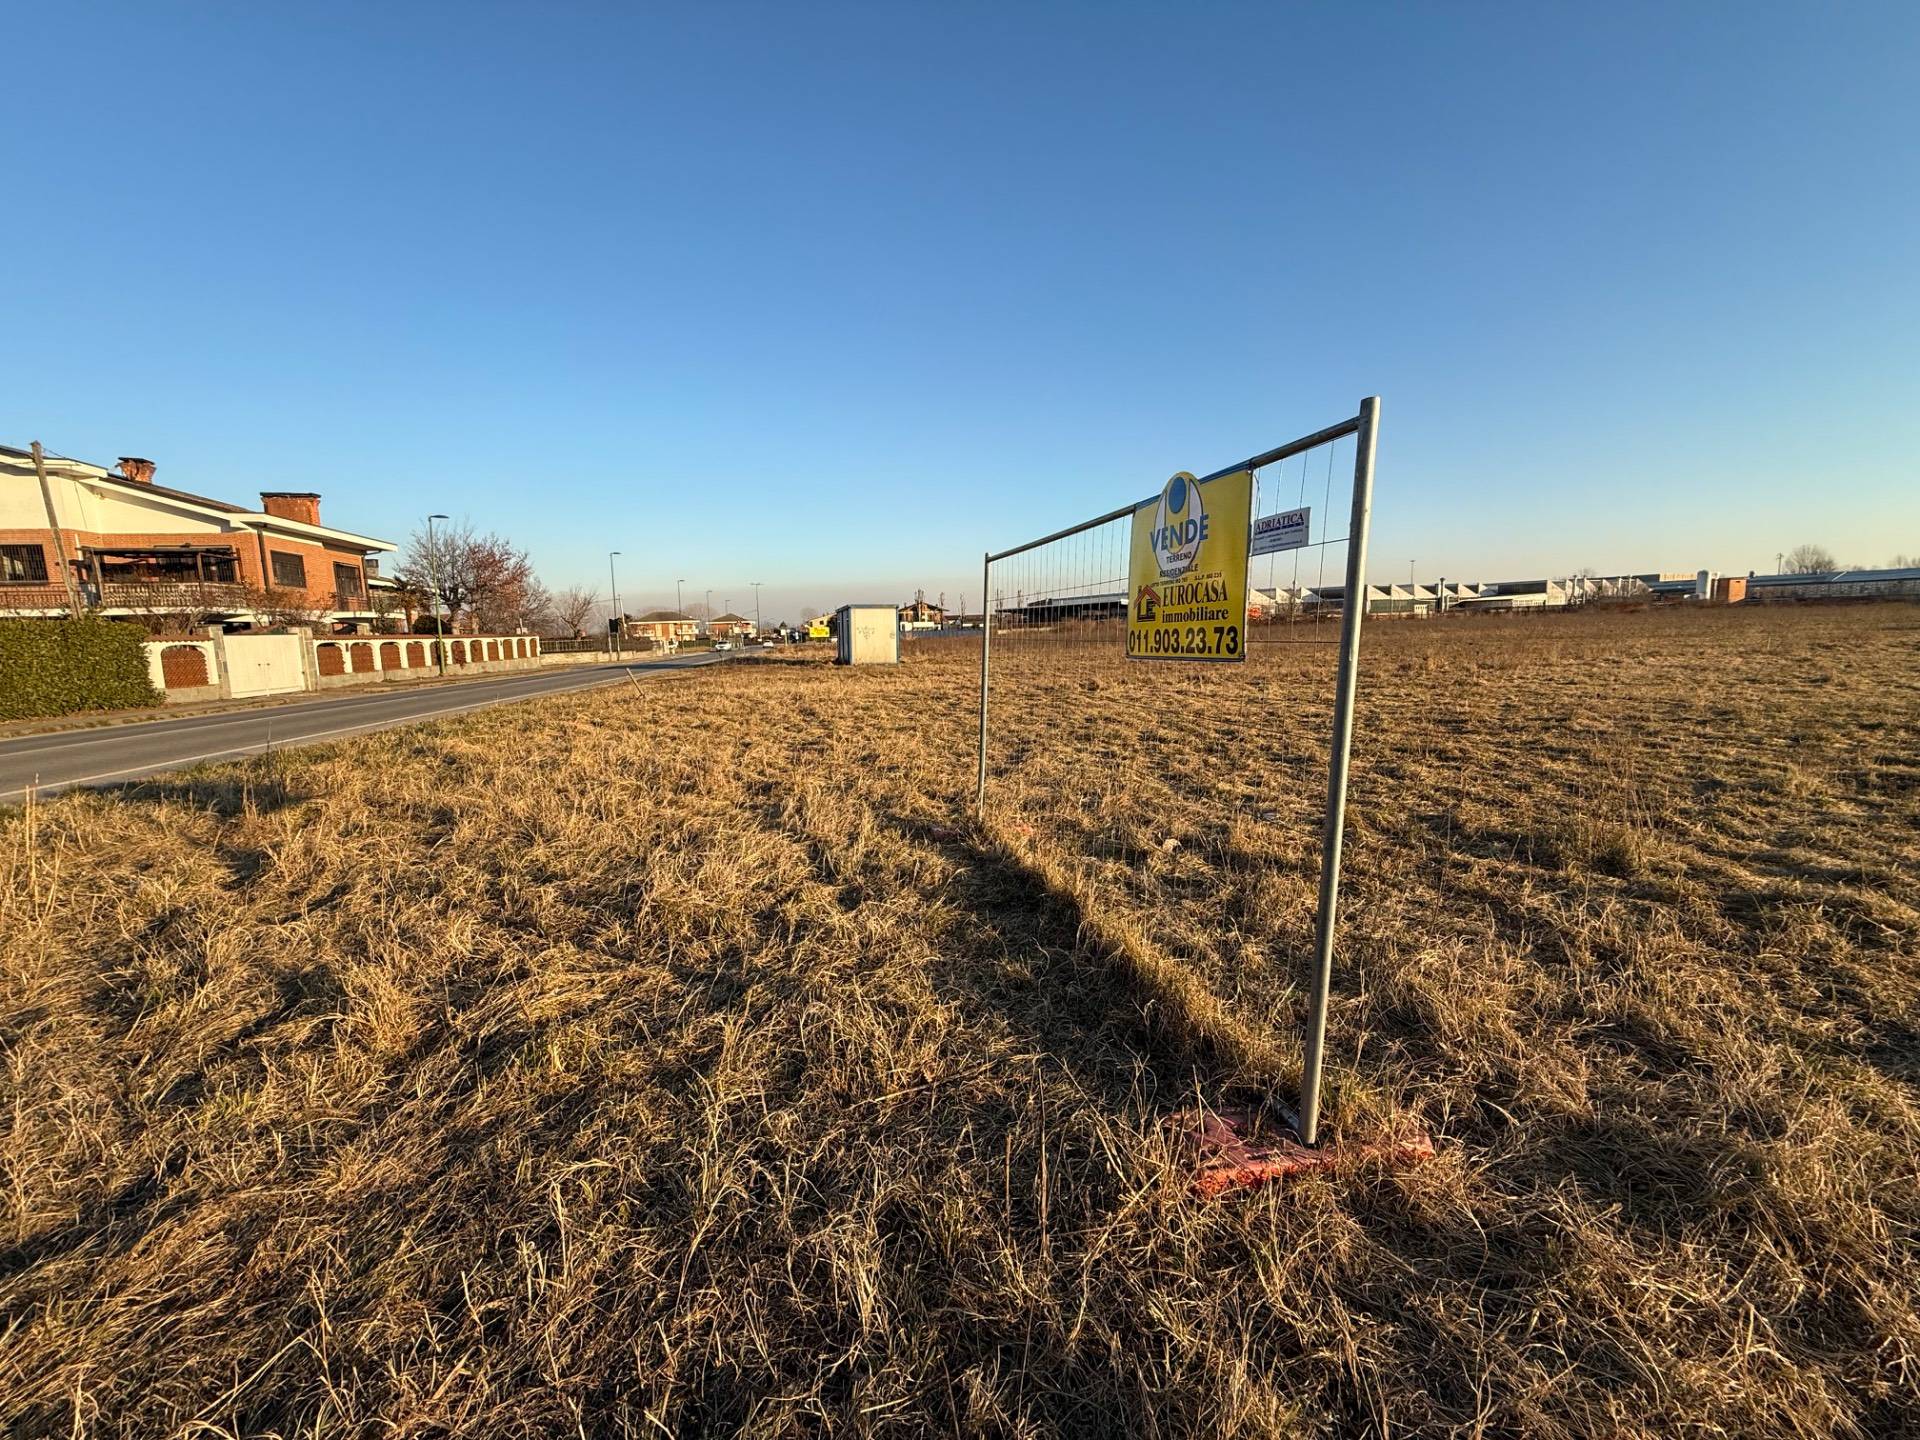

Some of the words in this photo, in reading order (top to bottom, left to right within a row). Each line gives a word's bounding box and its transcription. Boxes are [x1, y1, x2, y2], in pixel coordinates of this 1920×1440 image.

[1150, 514, 1210, 552] VENDE
[1256, 512, 1304, 532] ADRIATICA
[1166, 551, 1192, 563] TERRENO
[1163, 580, 1228, 607] EUROCASA
[1162, 607, 1229, 623] immobiliare
[1129, 626, 1238, 654] 011.903.23.73
